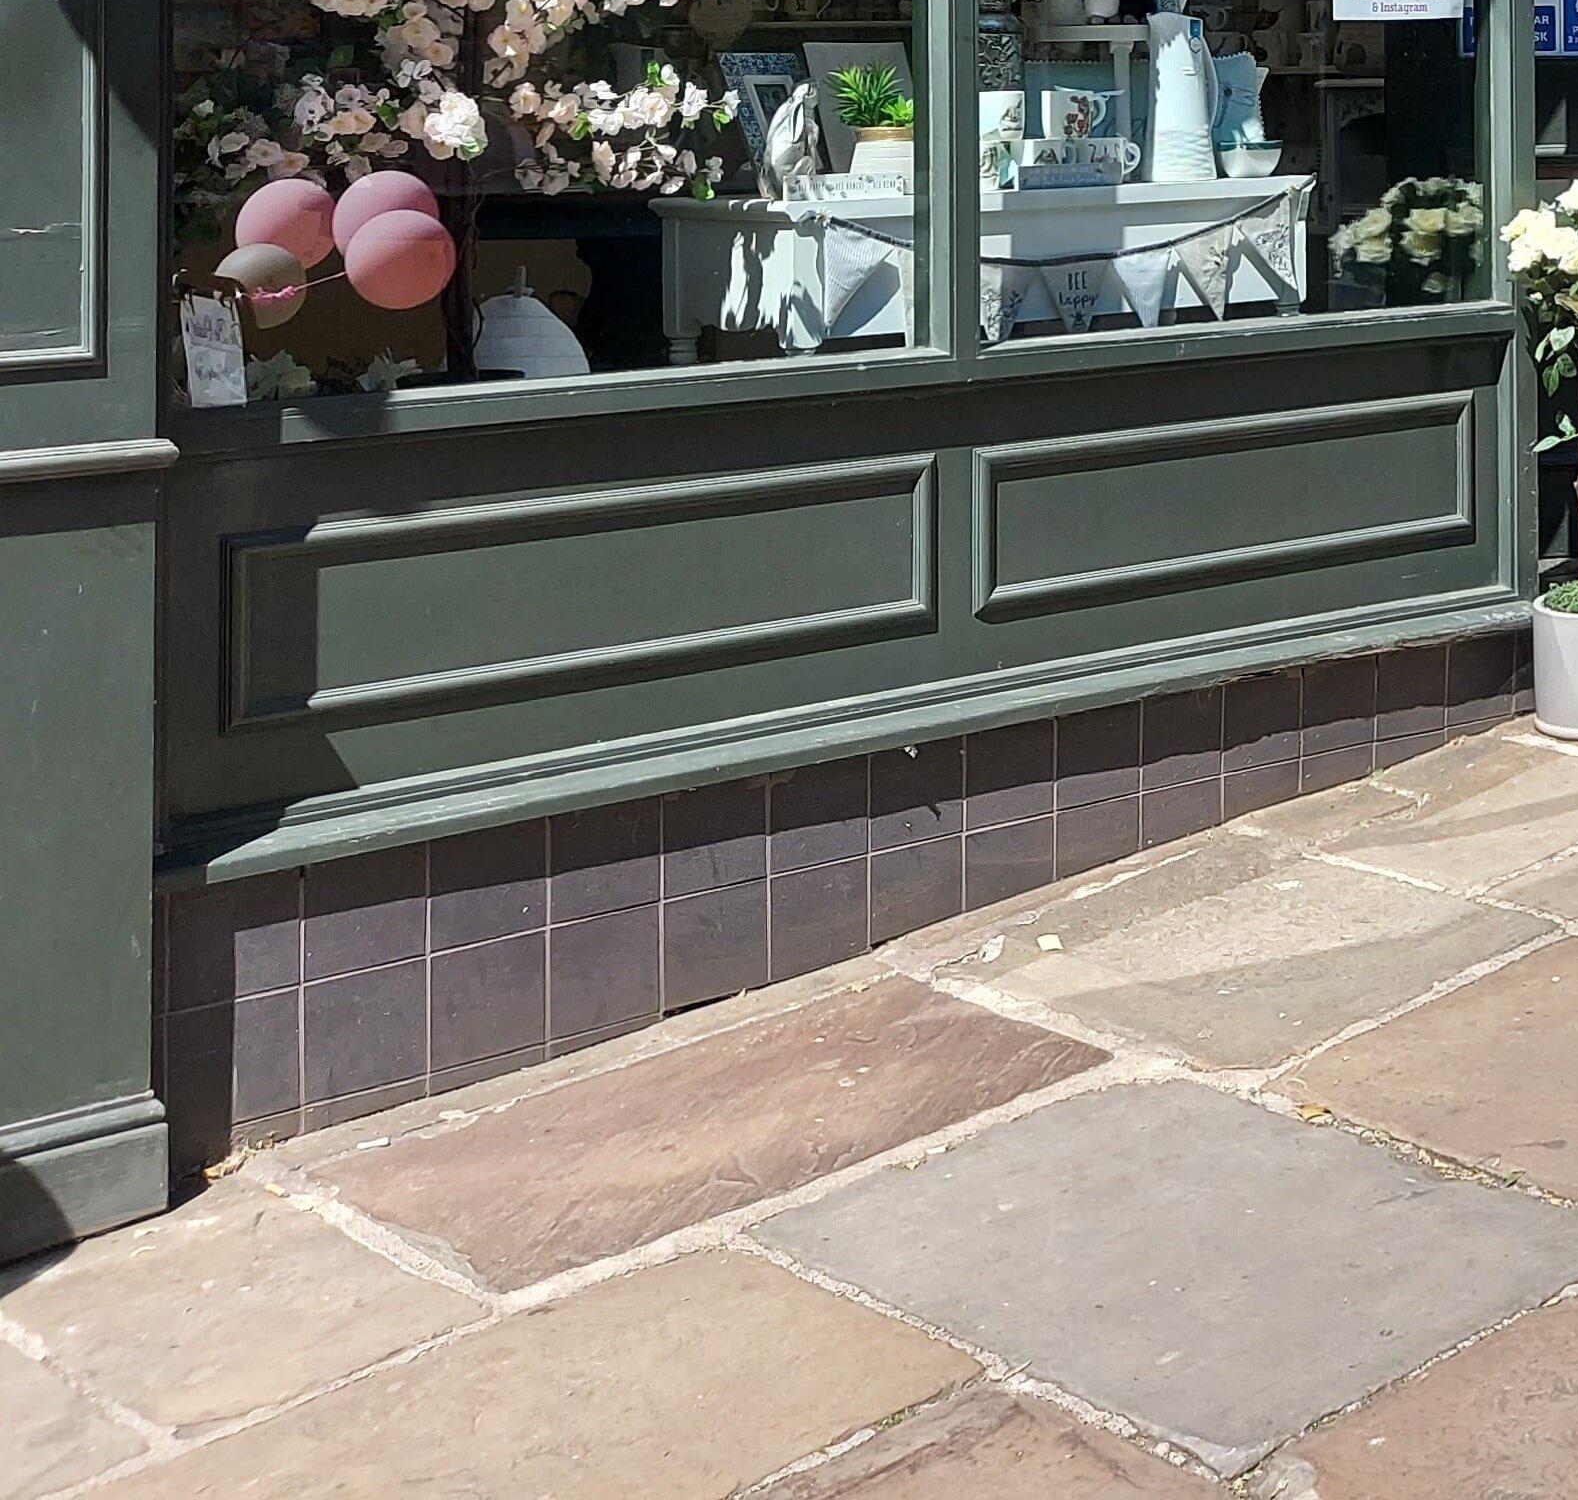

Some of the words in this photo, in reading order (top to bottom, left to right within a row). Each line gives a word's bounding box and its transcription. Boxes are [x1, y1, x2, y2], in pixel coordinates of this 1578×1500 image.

[1372, 2, 1379, 12] &
[1380, 2, 1428, 15] Instagram
[1067, 271, 1088, 290] BEE
